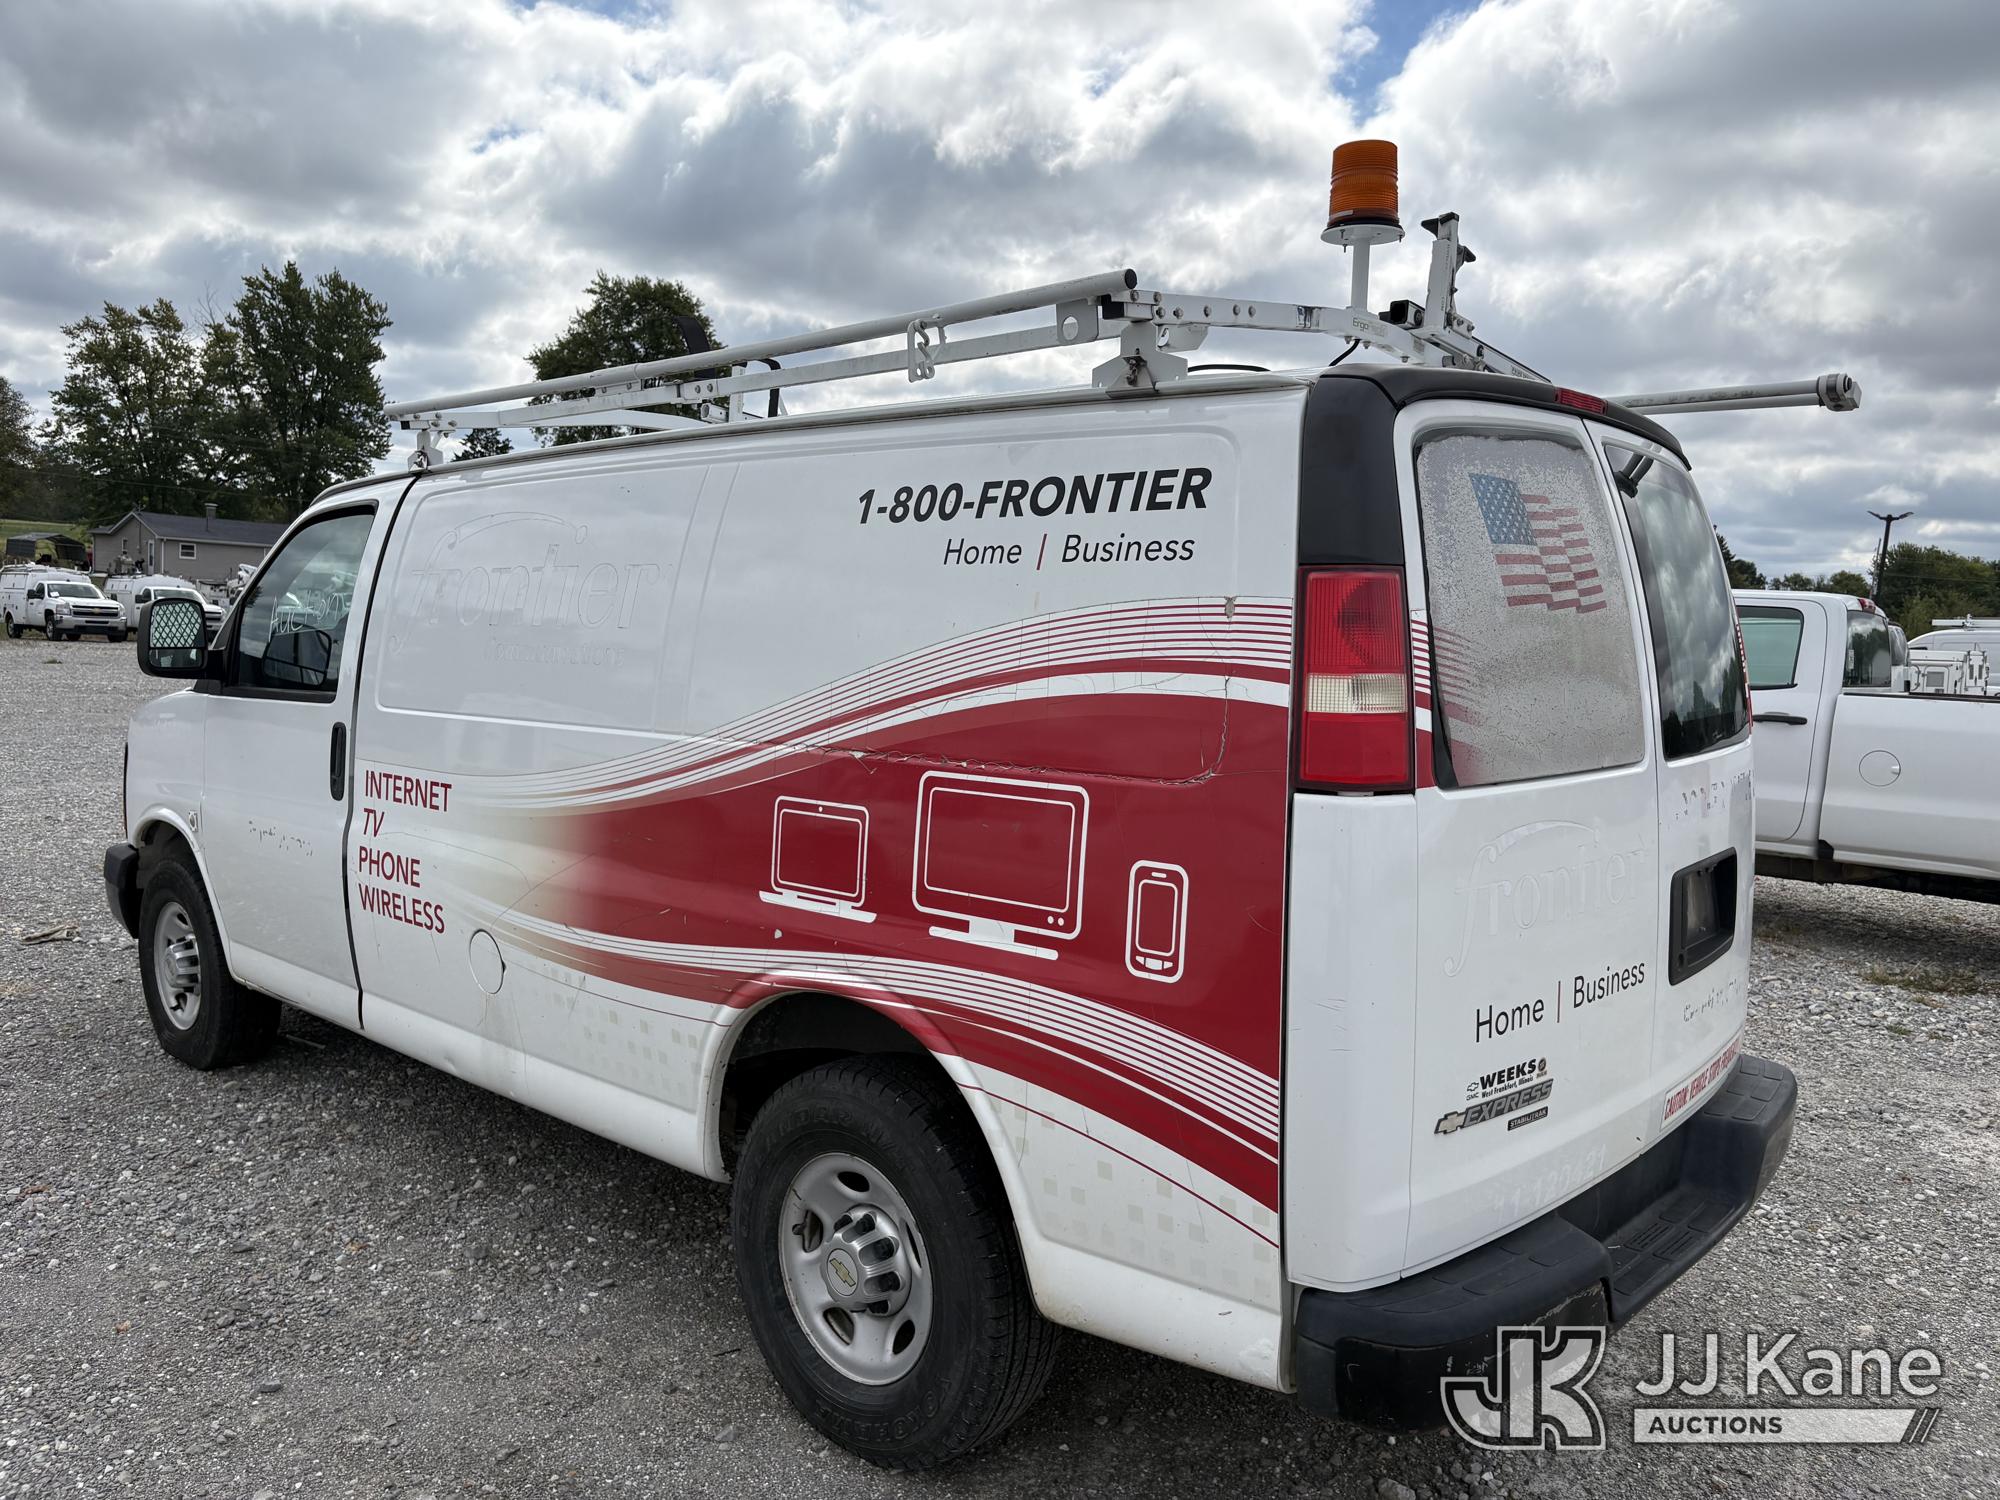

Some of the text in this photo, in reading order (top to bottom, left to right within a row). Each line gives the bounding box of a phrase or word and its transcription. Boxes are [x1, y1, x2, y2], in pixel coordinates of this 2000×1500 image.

[857, 467, 1213, 524] 1-800-FRONTIER
[943, 532, 1196, 565] Home Business
[364, 769, 453, 813] INTERNET
[363, 807, 386, 838] TV
[358, 845, 421, 889] PHONE
[358, 883, 446, 934] WIRELESS
[1475, 998, 1545, 1044] Home
[1573, 962, 1646, 1009] Business
[1479, 1058, 1537, 1091] WEEKS
[1462, 1078, 1554, 1129] EXPRESS
